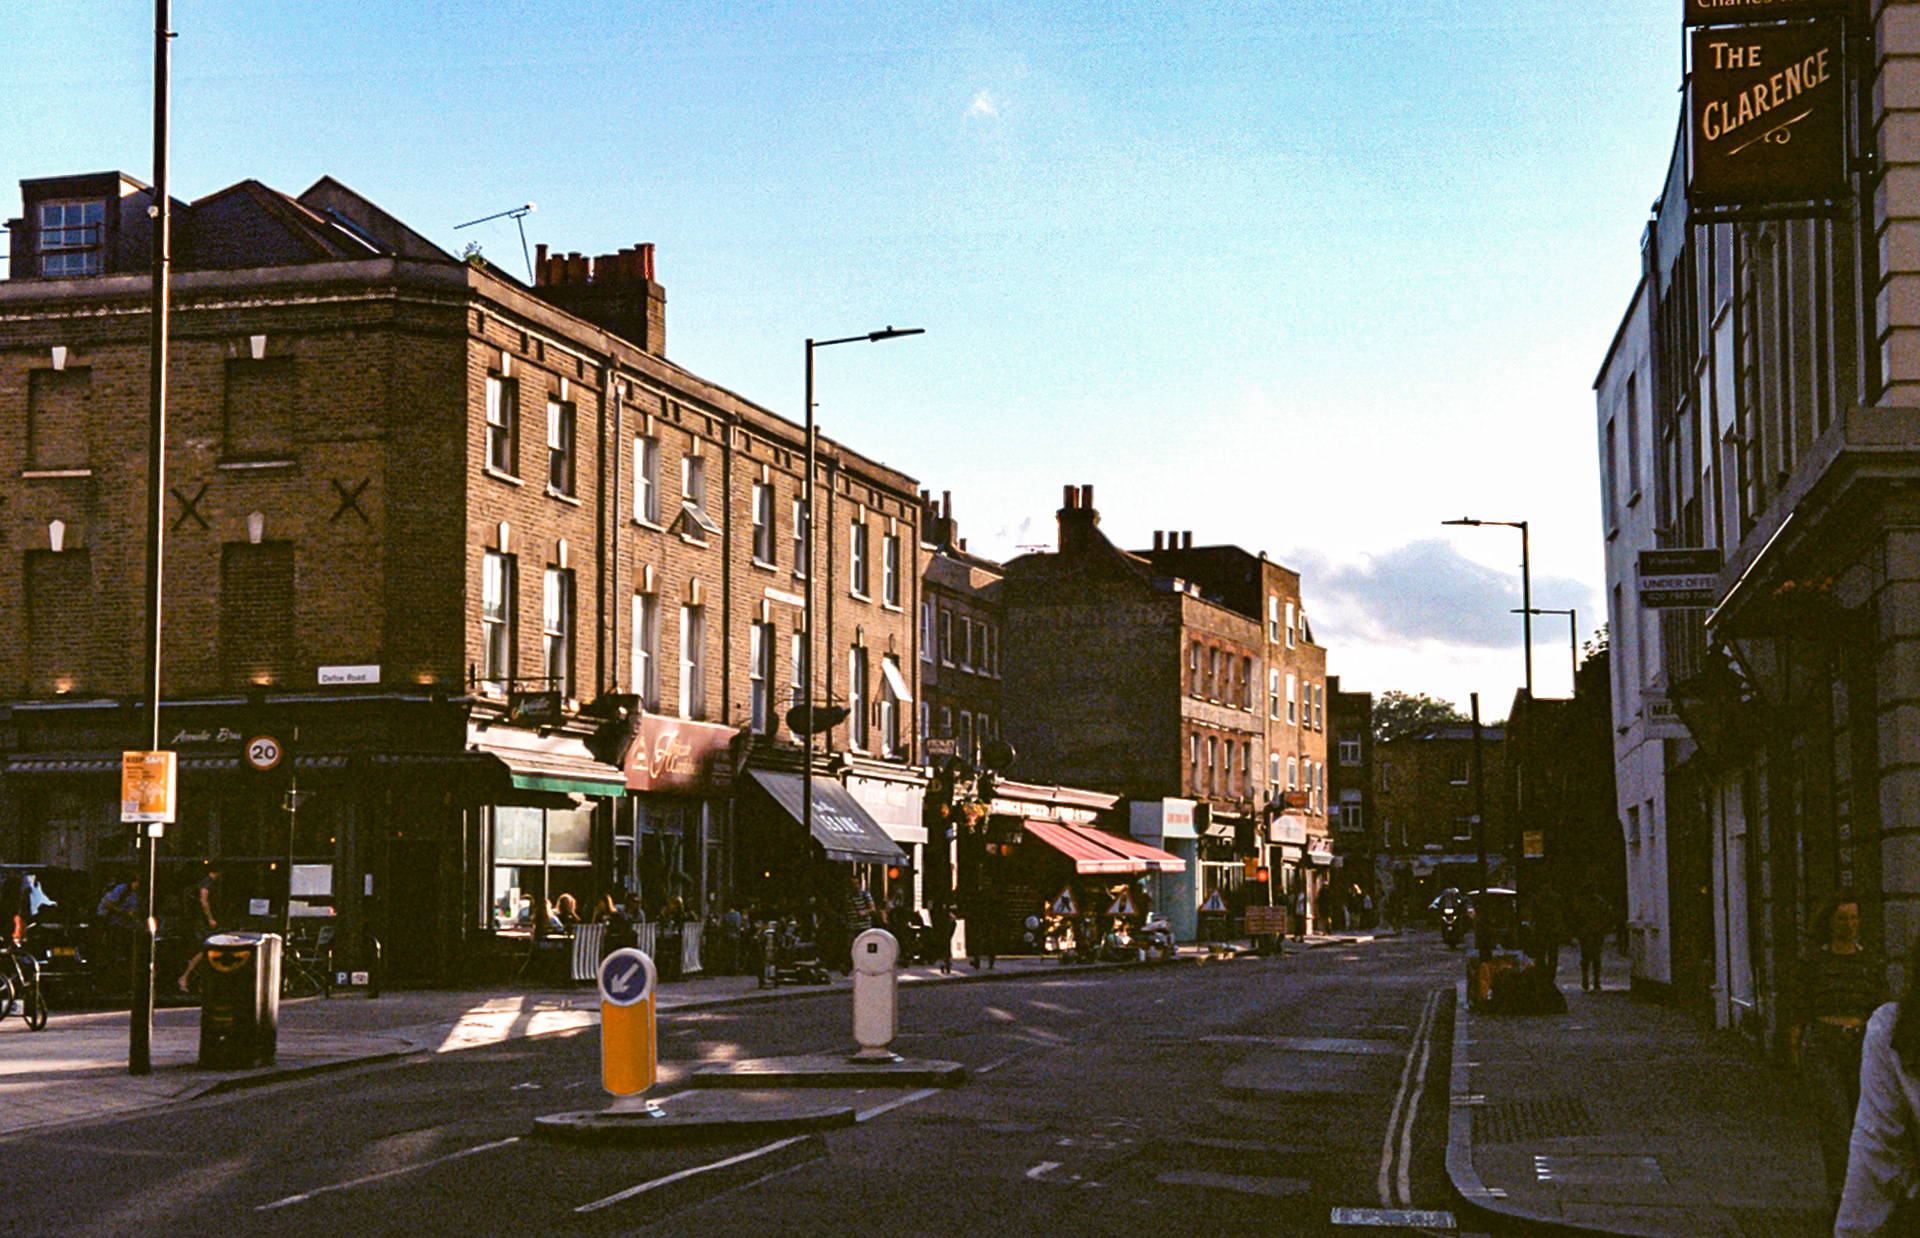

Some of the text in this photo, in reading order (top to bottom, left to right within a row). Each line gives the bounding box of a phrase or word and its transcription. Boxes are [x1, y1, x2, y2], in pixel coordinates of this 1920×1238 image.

[1709, 42, 1762, 70] THE
[1702, 48, 1830, 141] CLARENCE
[1643, 578, 1714, 589] UNDER OFFE
[252, 745, 276, 760] 20
